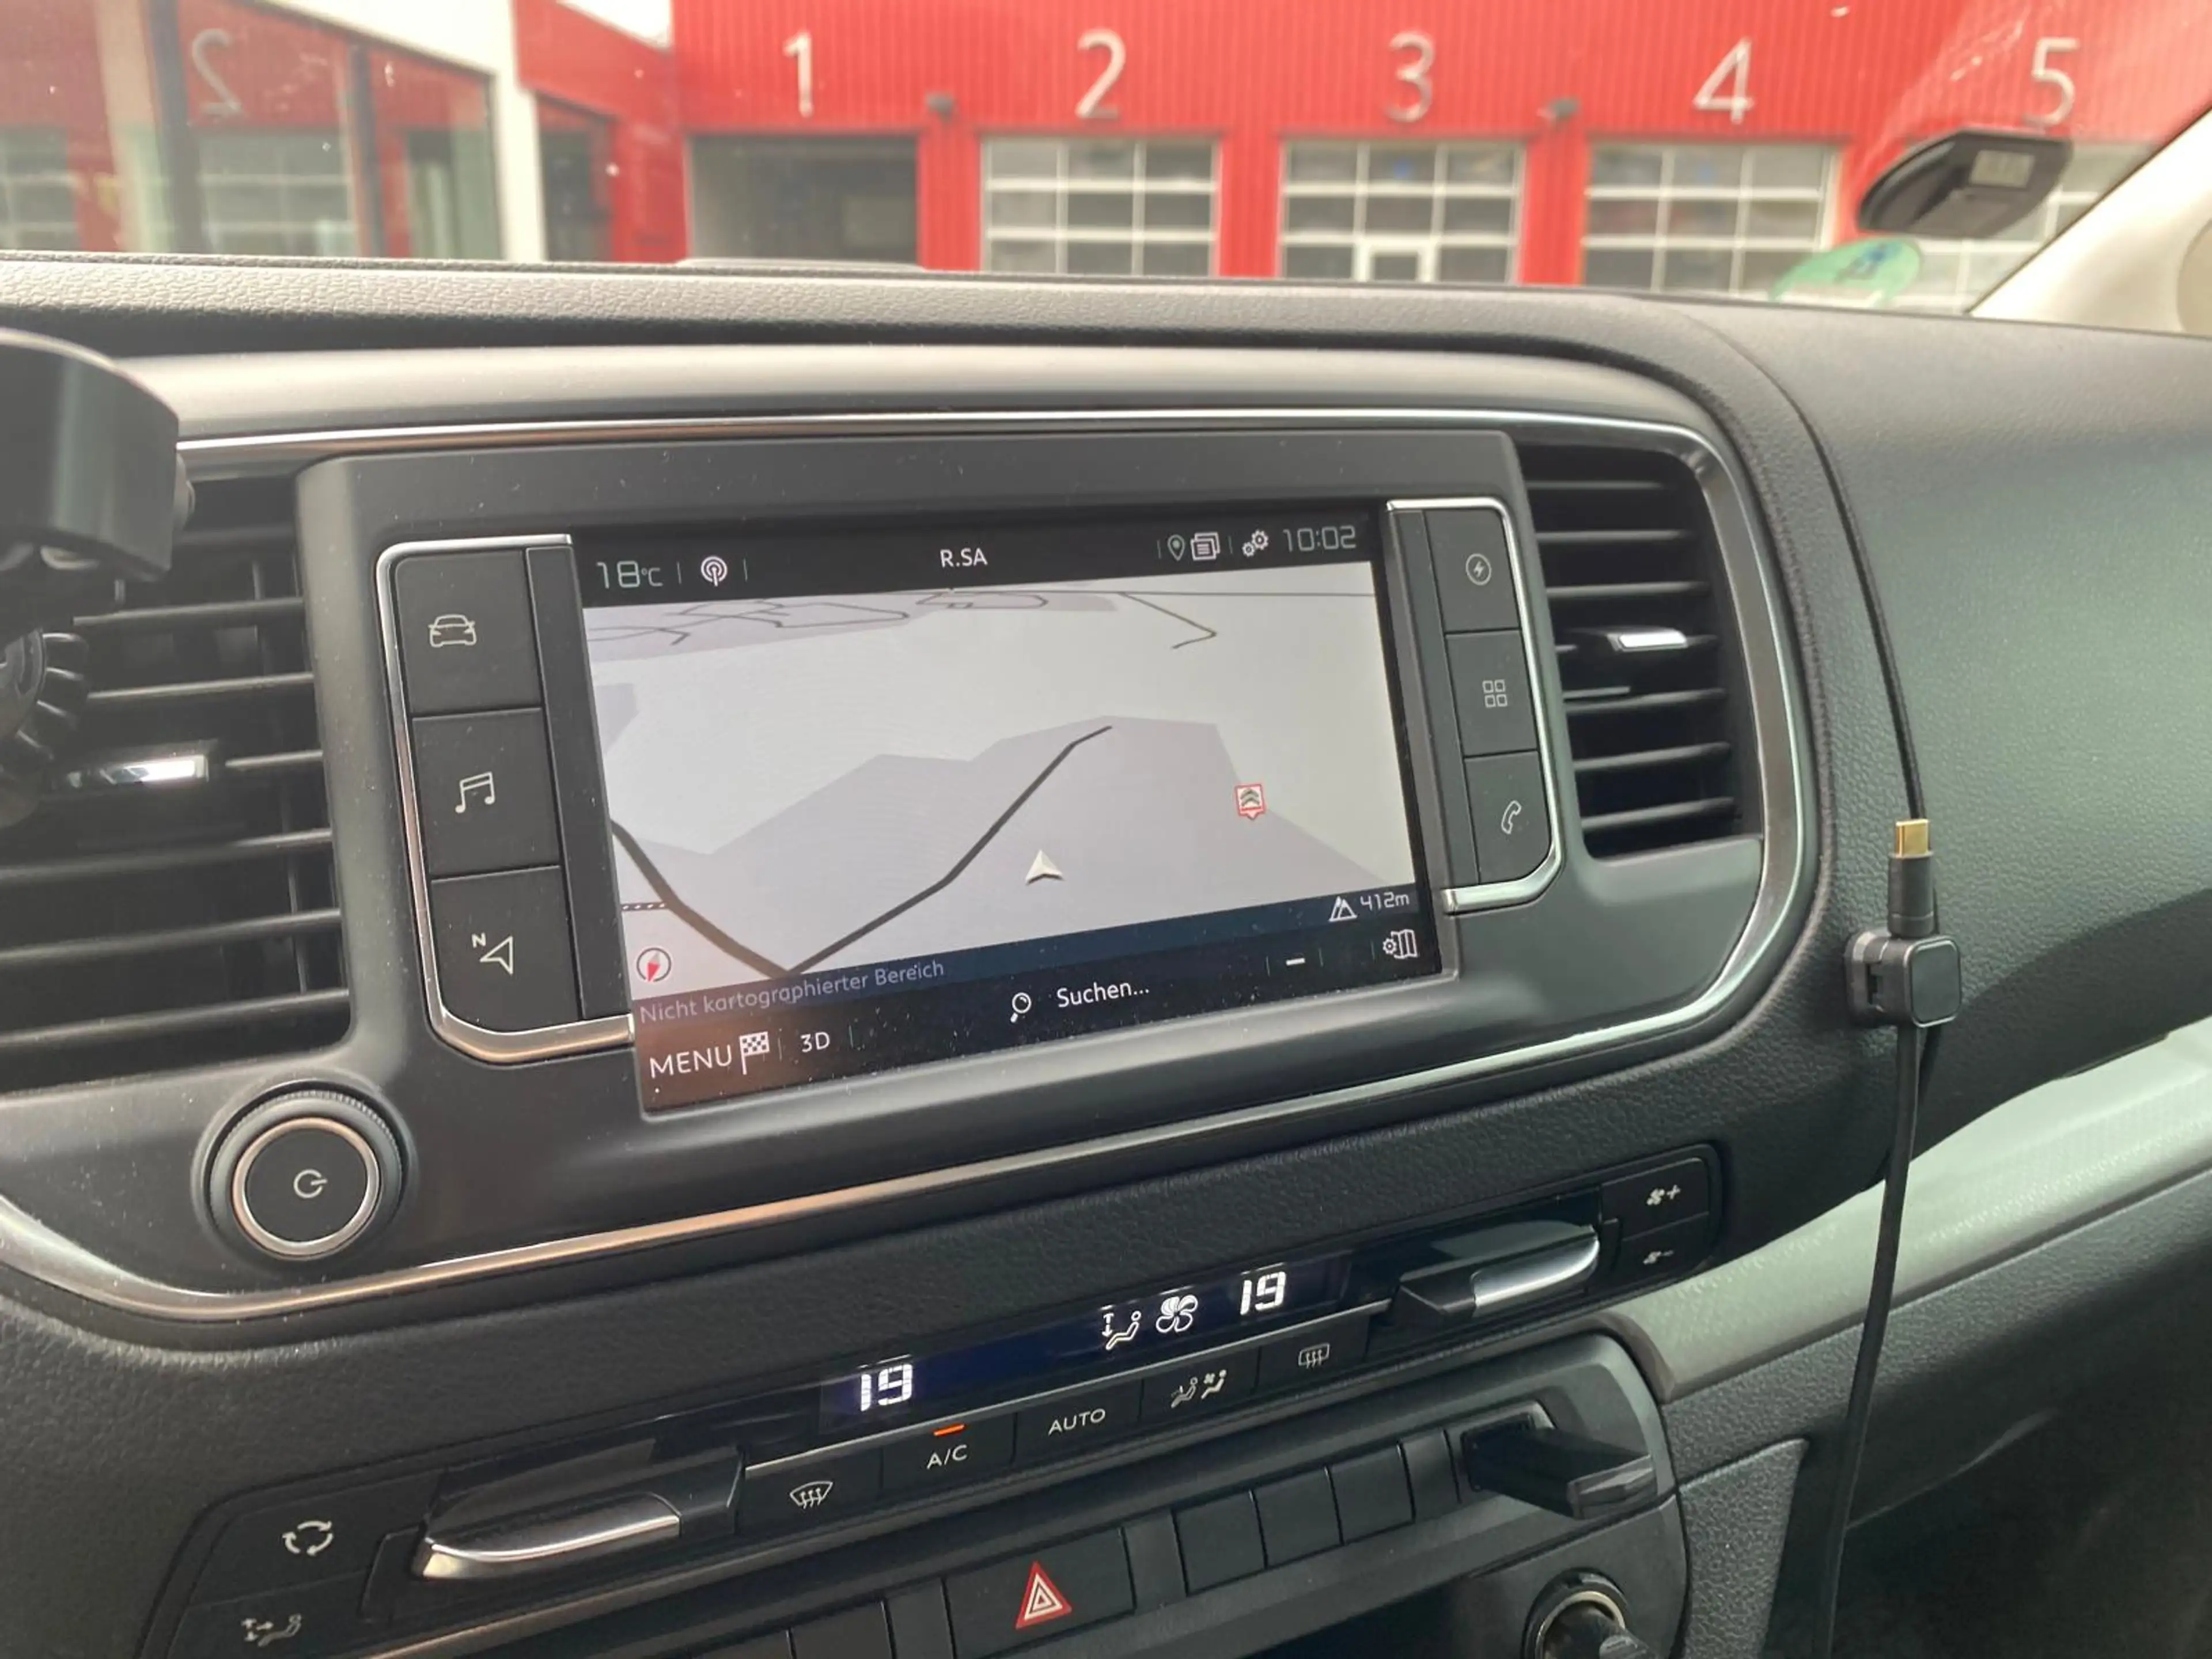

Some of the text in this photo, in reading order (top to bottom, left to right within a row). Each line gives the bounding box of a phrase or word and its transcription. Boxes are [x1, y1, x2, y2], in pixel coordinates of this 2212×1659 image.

[782, 29, 813, 118] 1
[1075, 28, 1127, 119] 2
[1385, 30, 1435, 123] 3
[1692, 36, 1753, 123] 4
[2022, 37, 2080, 128] 5
[1283, 525, 1357, 552] 10:02
[940, 548, 988, 568] R.SA
[1359, 891, 1410, 910] 412m
[472, 933, 486, 948] N
[640, 960, 945, 1024] Nicht kartographierter Bereich
[1056, 982, 1149, 1008] Suchen...
[800, 1031, 831, 1053] 3D
[649, 1044, 733, 1079] MENU
[1240, 1271, 1287, 1316] 19
[859, 1363, 914, 1411] 19
[1048, 1408, 1106, 1435] AUTO
[926, 1444, 968, 1469] A/C
